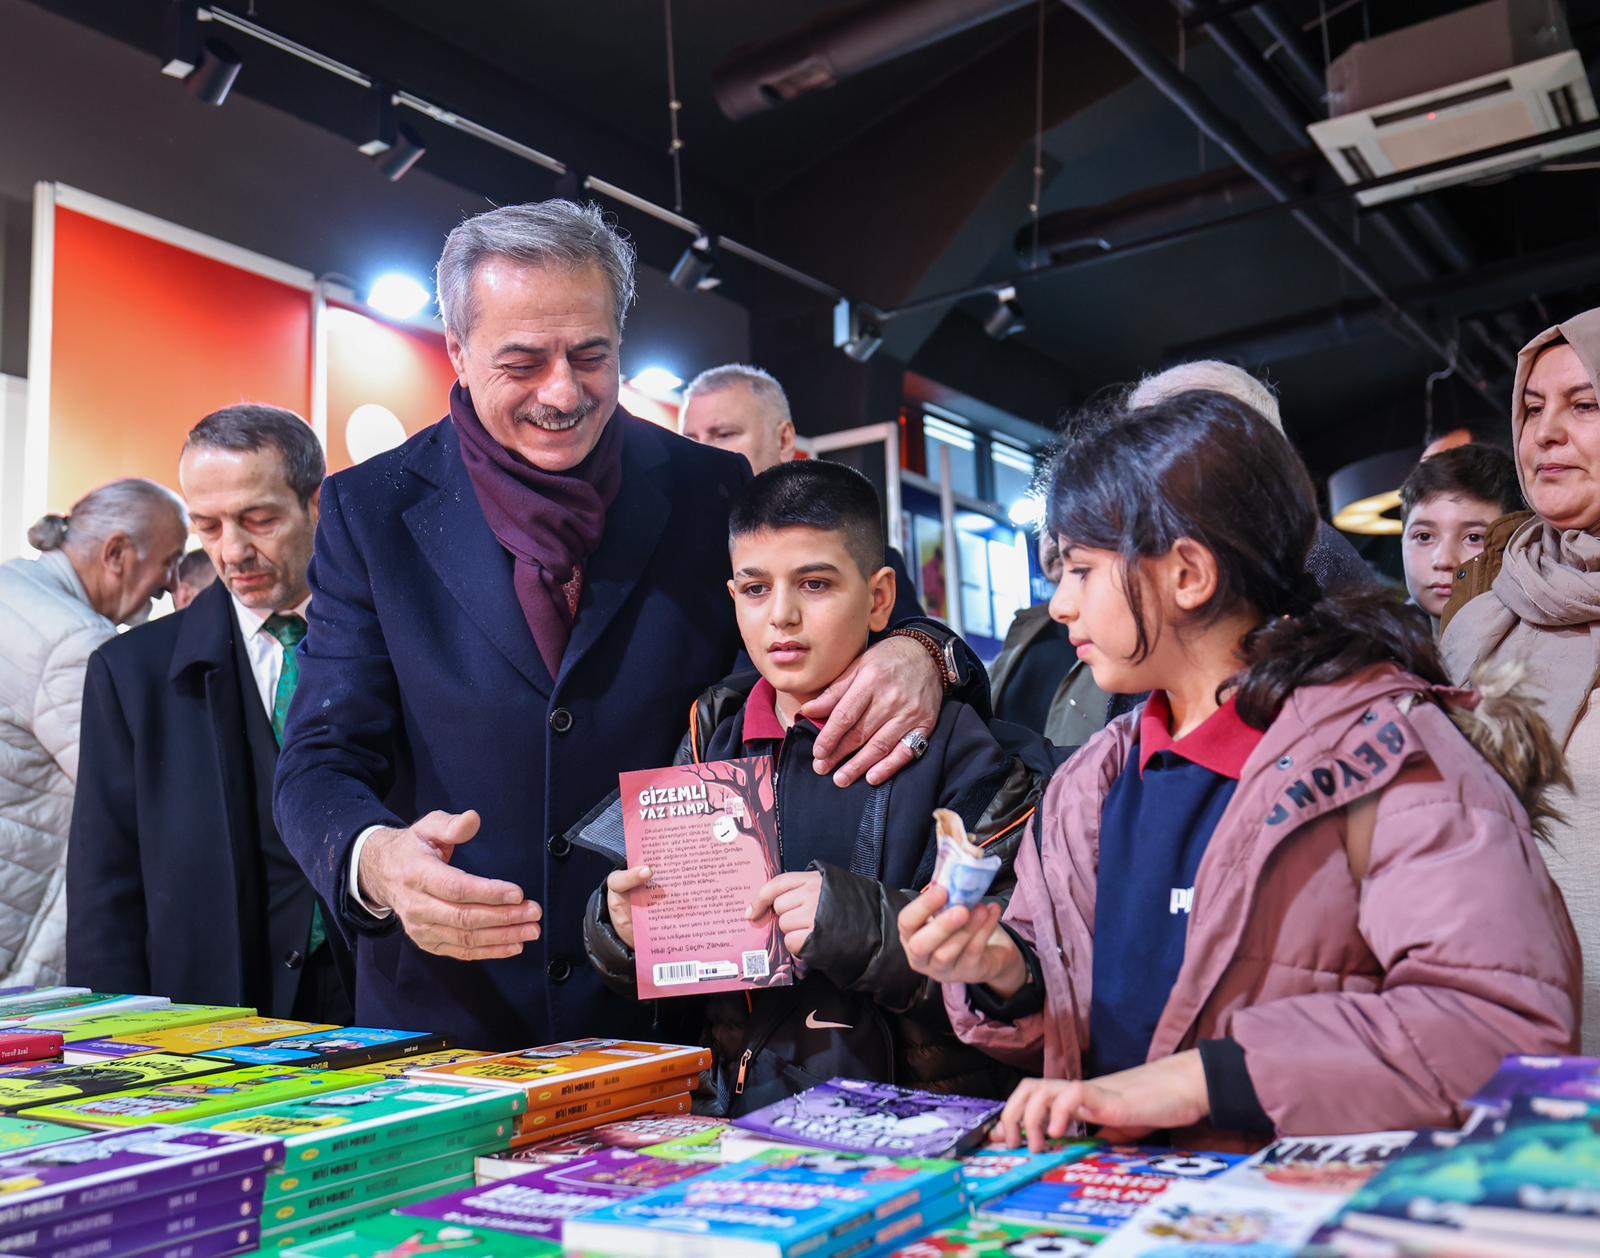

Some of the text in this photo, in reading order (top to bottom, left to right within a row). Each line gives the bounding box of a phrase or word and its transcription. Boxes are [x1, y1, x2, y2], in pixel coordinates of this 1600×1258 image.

[639, 780, 707, 806] GİZEMLİ
[640, 806, 666, 820] YAZ
[670, 801, 710, 817] KAMPI
